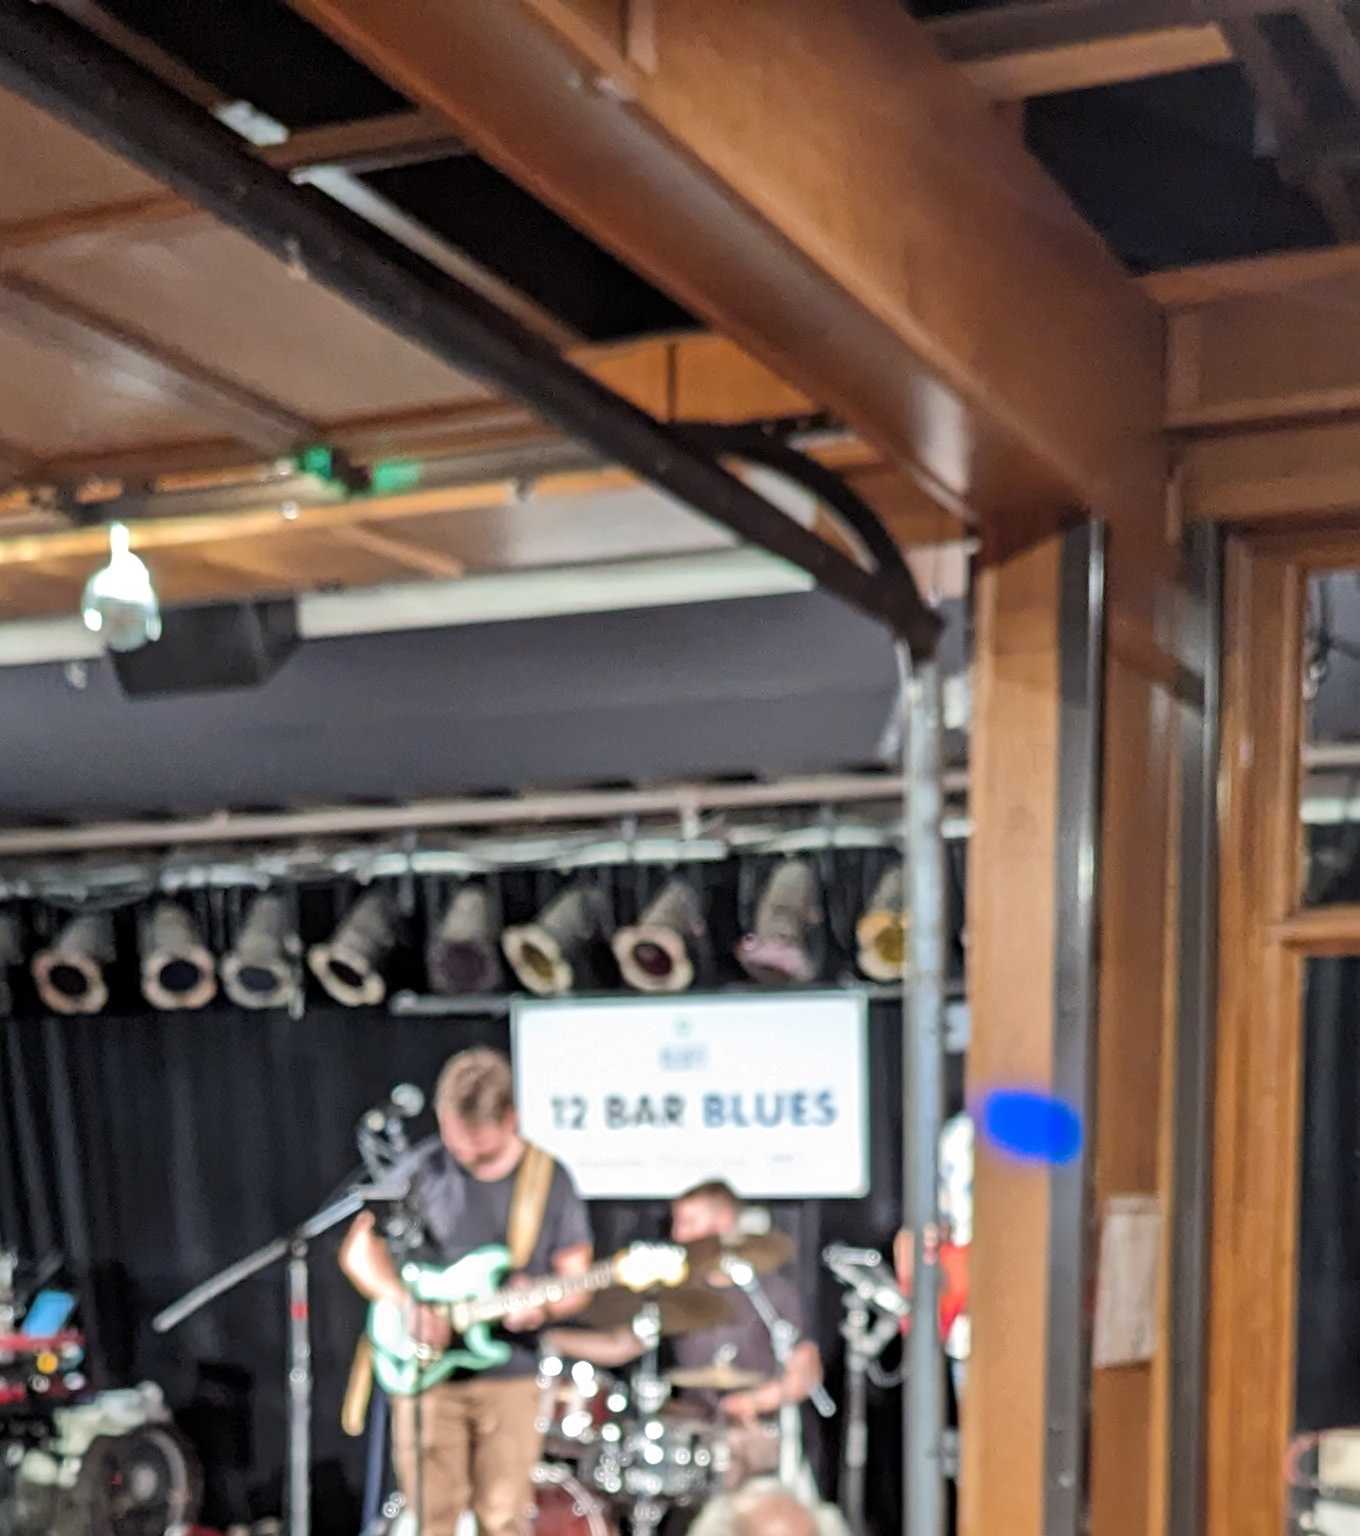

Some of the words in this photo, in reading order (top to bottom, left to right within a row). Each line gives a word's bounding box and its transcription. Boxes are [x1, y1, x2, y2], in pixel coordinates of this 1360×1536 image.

[551, 1095, 587, 1129] 12
[604, 1093, 687, 1129] BAR
[702, 1088, 838, 1127] BLUES
